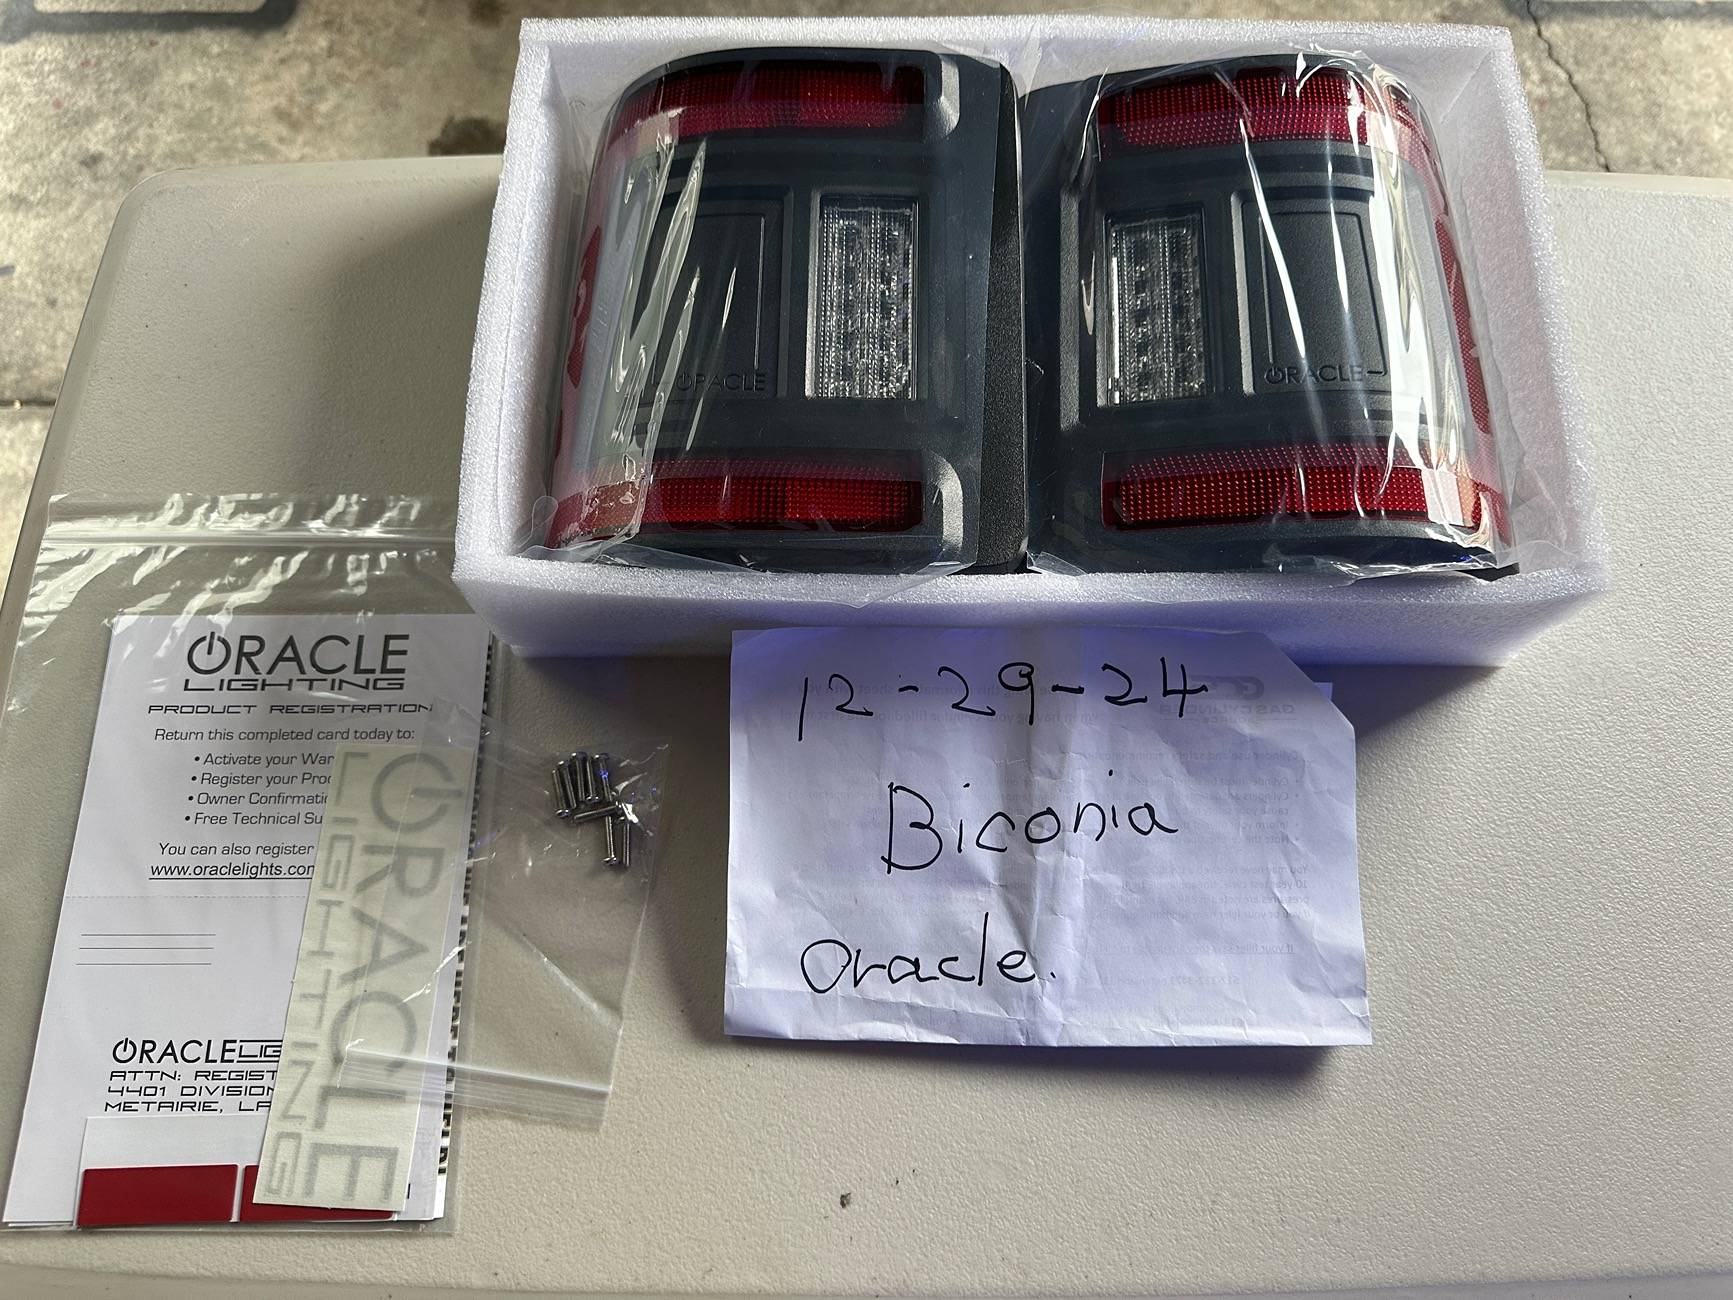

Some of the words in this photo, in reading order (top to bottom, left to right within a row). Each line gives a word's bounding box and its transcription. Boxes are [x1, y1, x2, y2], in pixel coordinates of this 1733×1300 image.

[1264, 365, 1363, 385] ORACLE
[187, 631, 410, 675] ORACLE
[183, 677, 405, 692] LIGHTING
[148, 704, 257, 715] PRODUCT
[269, 703, 434, 715] REGISTRATION
[154, 728, 204, 742] Return
[208, 728, 234, 742] this
[238, 728, 314, 743] completed
[316, 728, 350, 741] card
[353, 728, 394, 743] today
[397, 728, 416, 741] to:
[203, 753, 262, 766] Activate
[265, 755, 298, 769] your
[200, 773, 263, 789] Register
[265, 775, 298, 789] your
[197, 792, 246, 806] Owner
[194, 812, 228, 825] Free
[232, 812, 301, 825] Technical
[881, 769, 1179, 875] Biconia
[159, 842, 187, 856] You
[190, 845, 217, 856] can
[221, 843, 252, 856] also
[255, 843, 315, 859] register
[112, 1037, 238, 1064] ORACLE
[109, 1070, 182, 1082] ATTN:
[194, 1070, 278, 1081] REGIST
[107, 1085, 166, 1097] 4401
[104, 1101, 224, 1114] METAIRIE,
